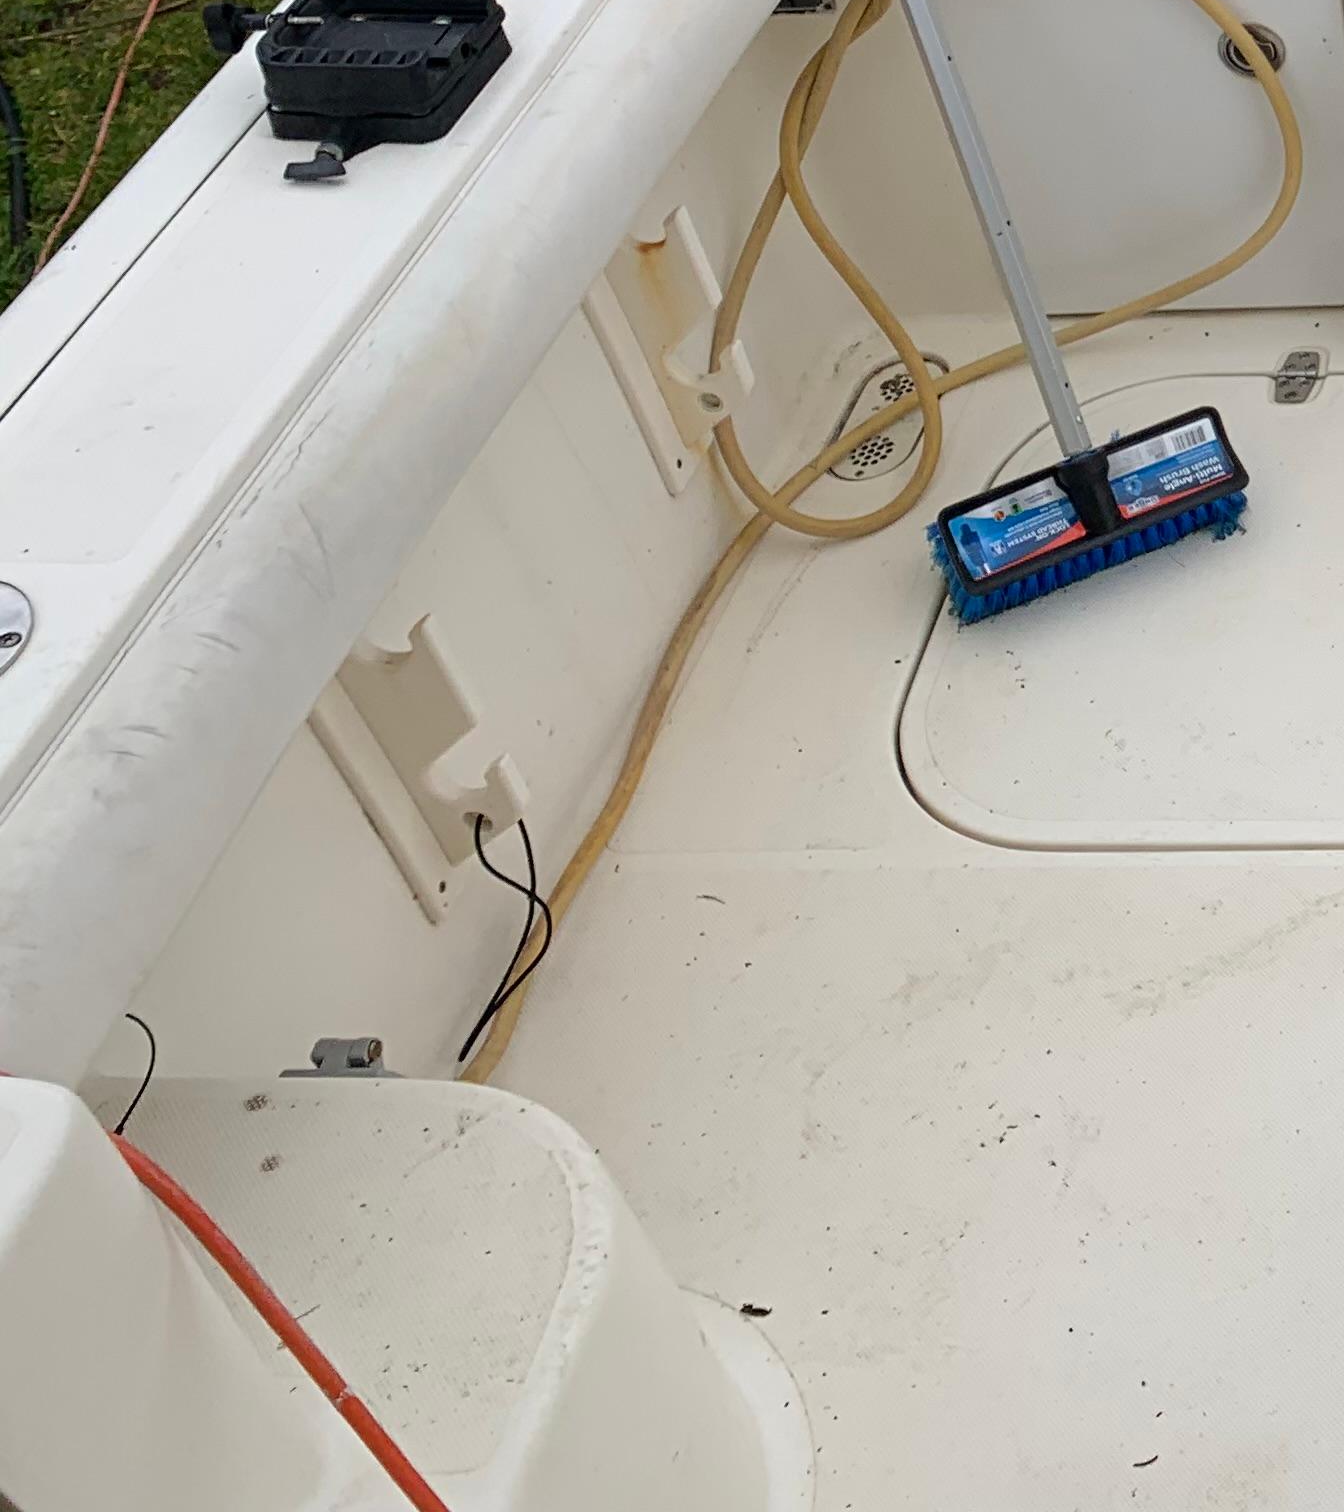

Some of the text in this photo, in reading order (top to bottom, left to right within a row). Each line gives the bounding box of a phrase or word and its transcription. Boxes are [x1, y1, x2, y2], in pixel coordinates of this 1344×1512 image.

[1191, 456, 1220, 472] Wash
[1159, 467, 1191, 484] Brush
[1163, 464, 1223, 491] Multi-Angle
